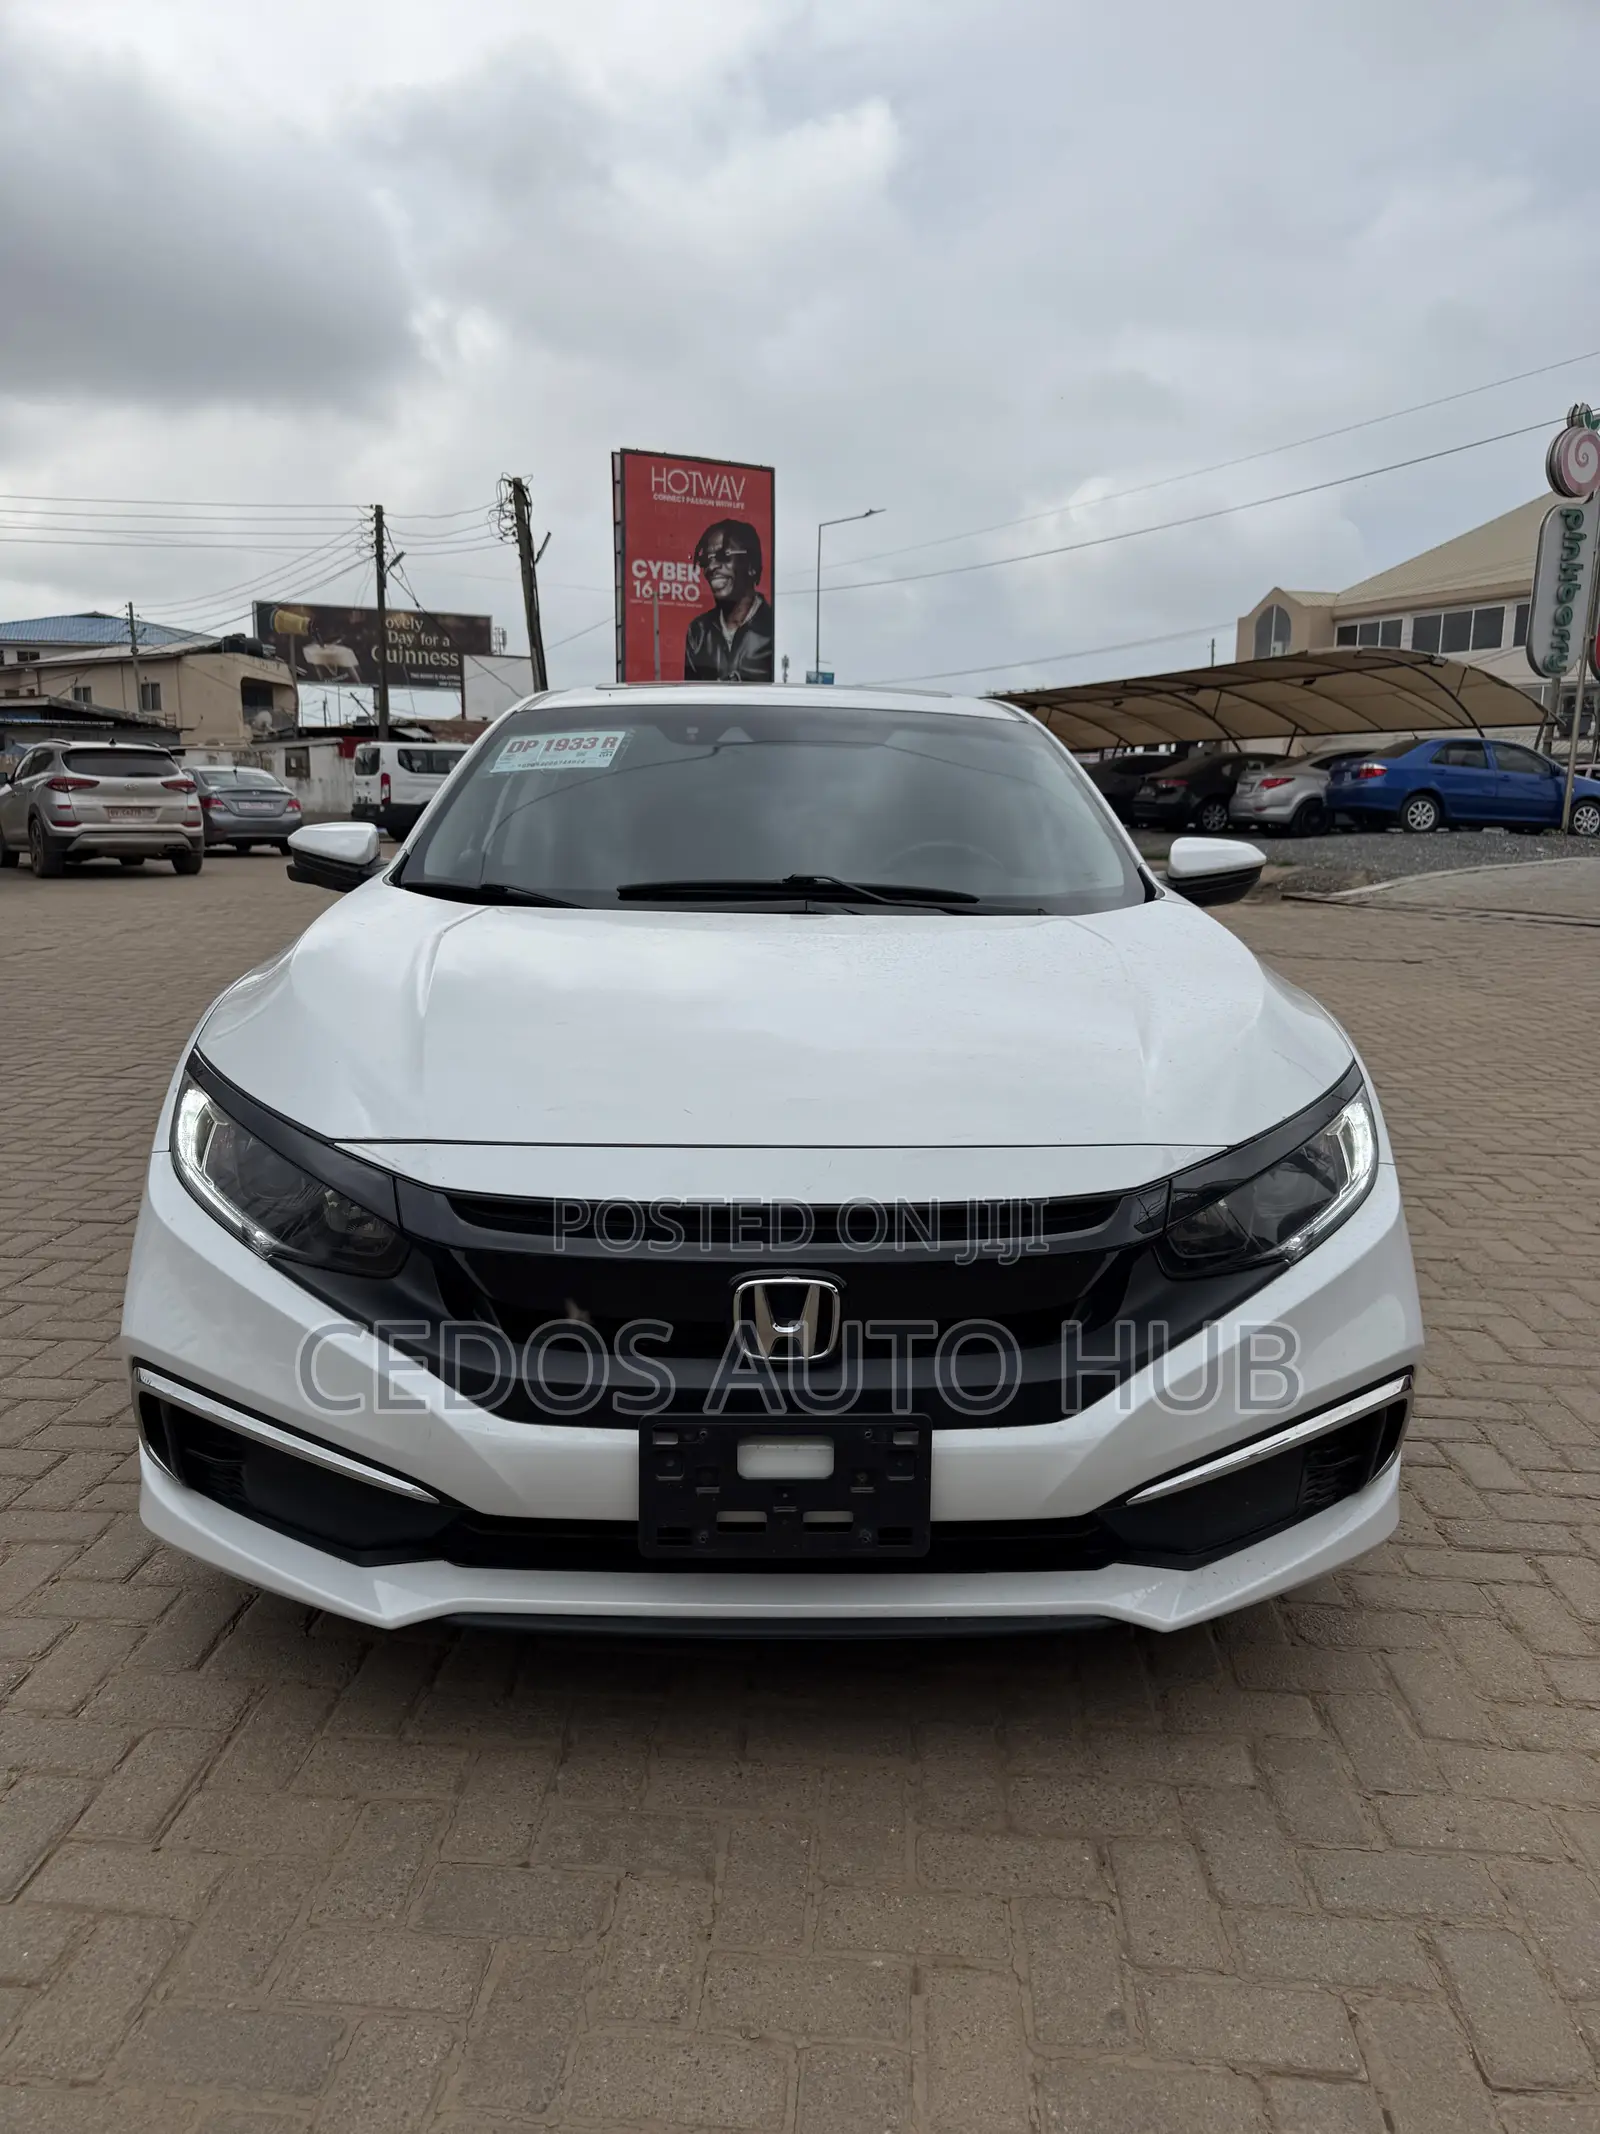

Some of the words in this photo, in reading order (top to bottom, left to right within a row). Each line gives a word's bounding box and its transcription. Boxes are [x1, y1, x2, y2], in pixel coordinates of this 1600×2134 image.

[652, 466, 746, 500] HOTWAV
[631, 559, 700, 583] CYBER
[633, 580, 653, 599] 16
[659, 581, 700, 601] PRO
[1543, 508, 1587, 674] pinkberry
[385, 616, 424, 633] ovely
[387, 630, 415, 647] Day
[421, 632, 438, 646] for
[442, 636, 450, 647] a
[544, 736, 599, 752] 1933
[601, 736, 619, 748] R
